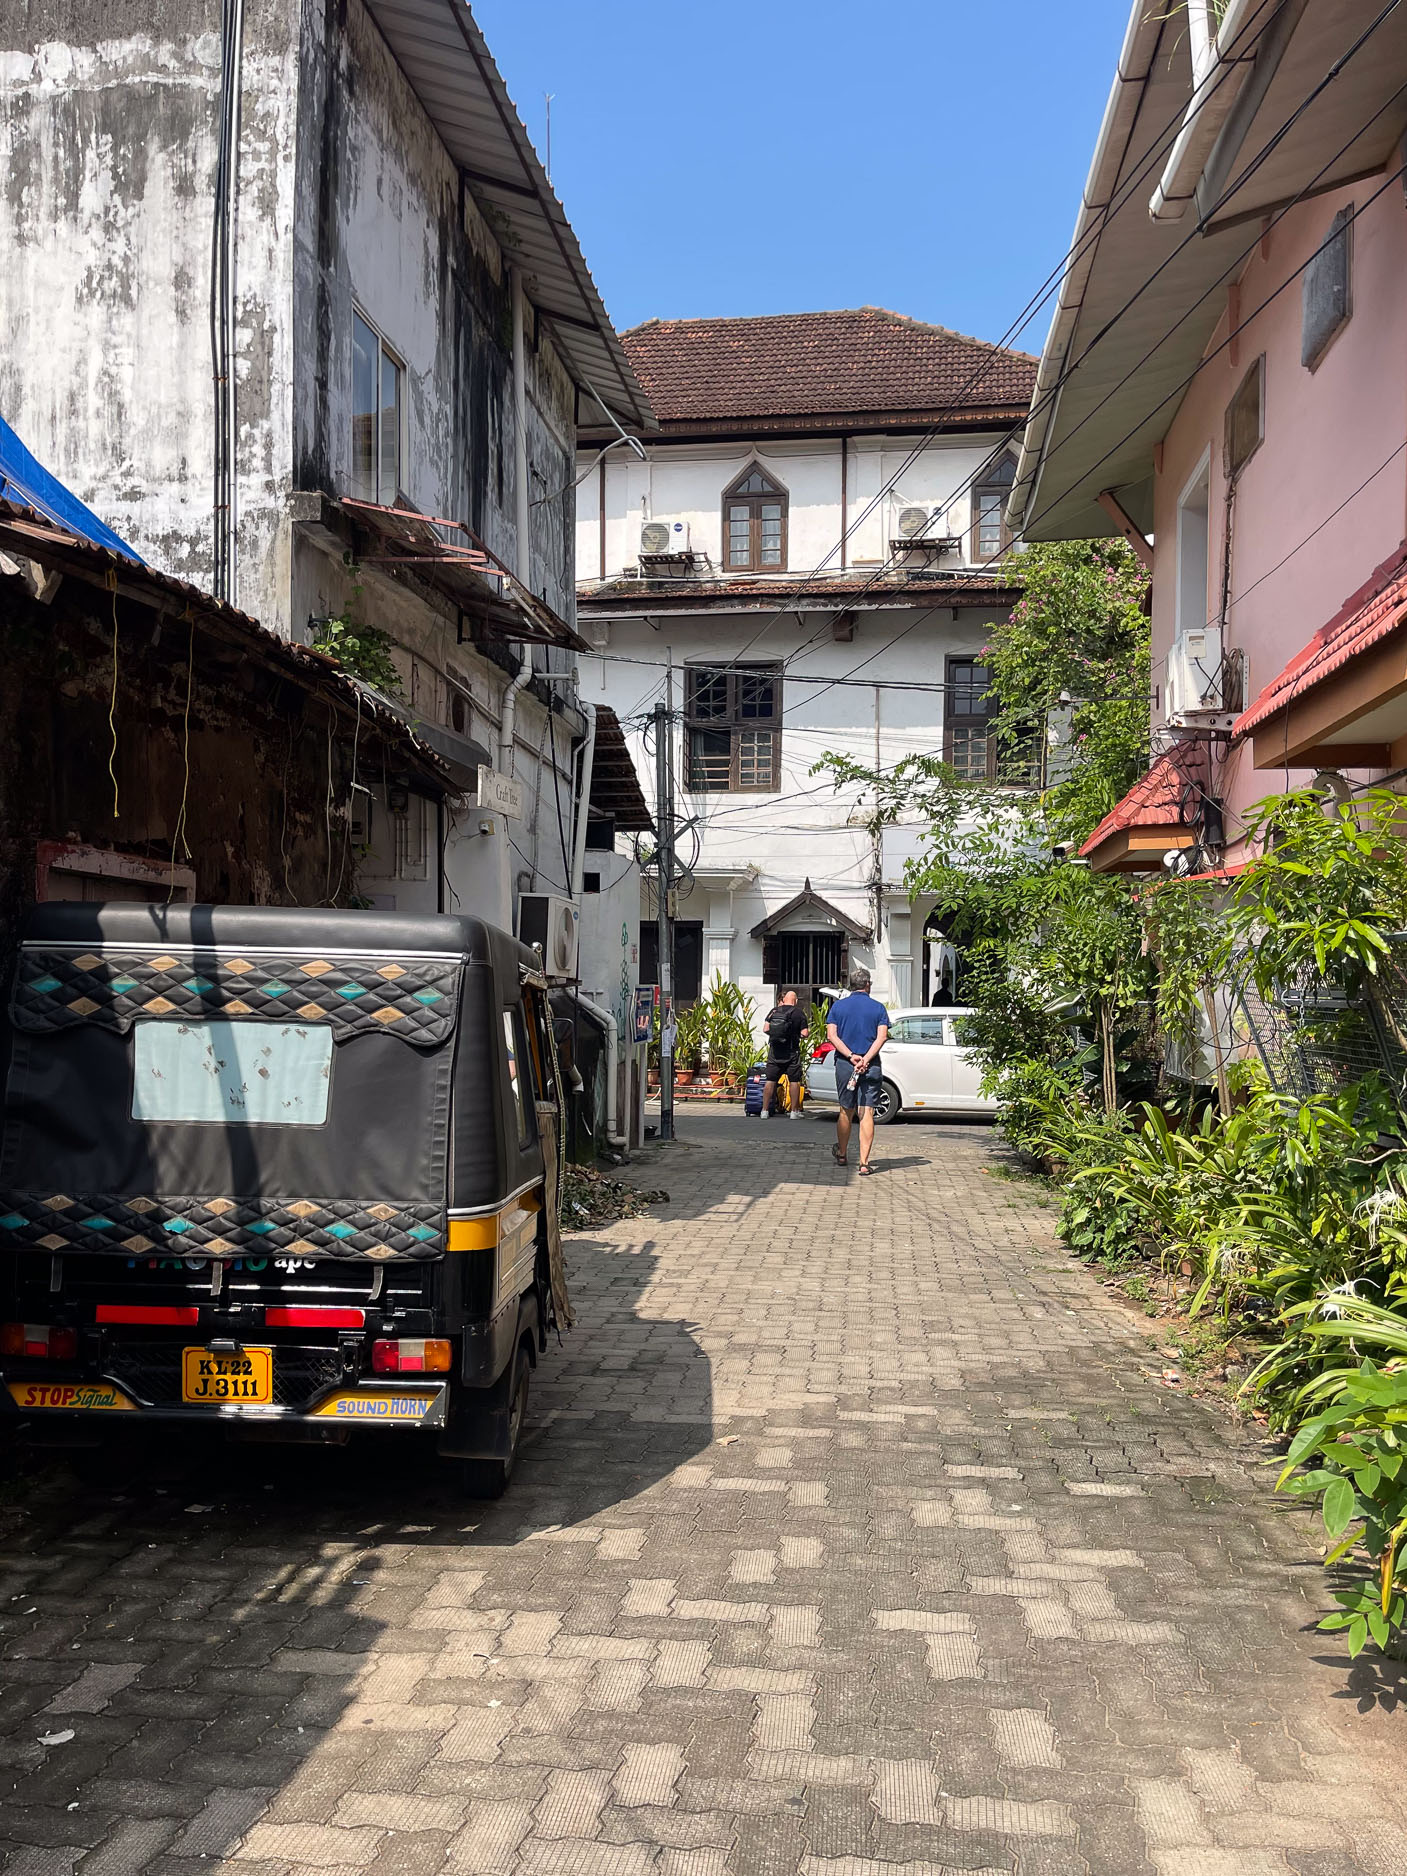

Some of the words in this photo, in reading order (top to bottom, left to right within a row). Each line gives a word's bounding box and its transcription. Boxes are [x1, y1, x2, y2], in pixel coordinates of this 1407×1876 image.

[496, 783, 509, 802] Craft
[509, 788, 518, 806] Tree
[24, 1386, 76, 1406] STOP
[69, 1387, 118, 1408] Signal
[336, 1400, 389, 1415] SOUND
[390, 1397, 429, 1416] HORN
